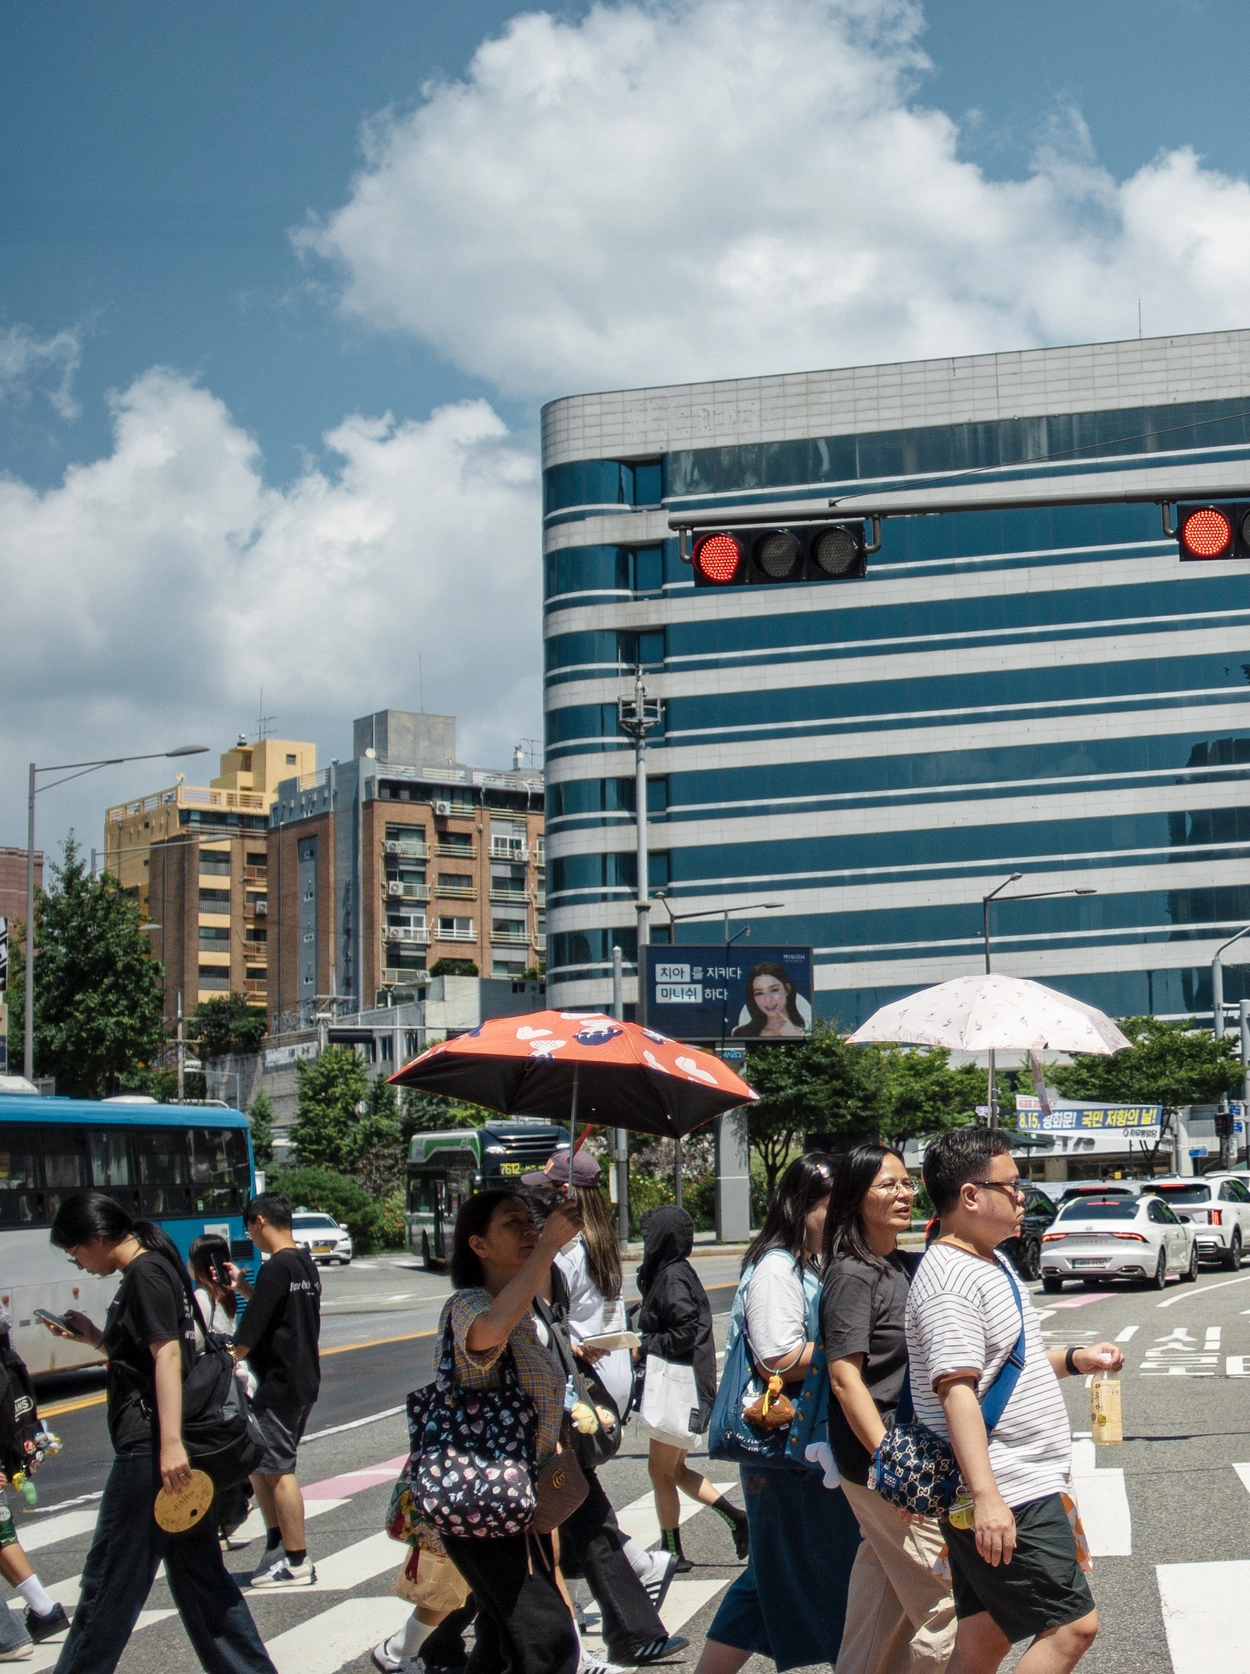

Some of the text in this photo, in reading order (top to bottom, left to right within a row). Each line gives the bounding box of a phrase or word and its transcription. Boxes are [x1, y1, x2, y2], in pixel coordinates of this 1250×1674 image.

[660, 966, 742, 980] 치아 를 지키다
[660, 987, 729, 1000] 미니쉬 하다
[1019, 1111, 1041, 1129] 8.15,
[1082, 1110, 1104, 1128] 국민
[1105, 1109, 1139, 1127] 저항의
[1141, 1108, 1158, 1125] 날!
[500, 1163, 521, 1175] 7612
